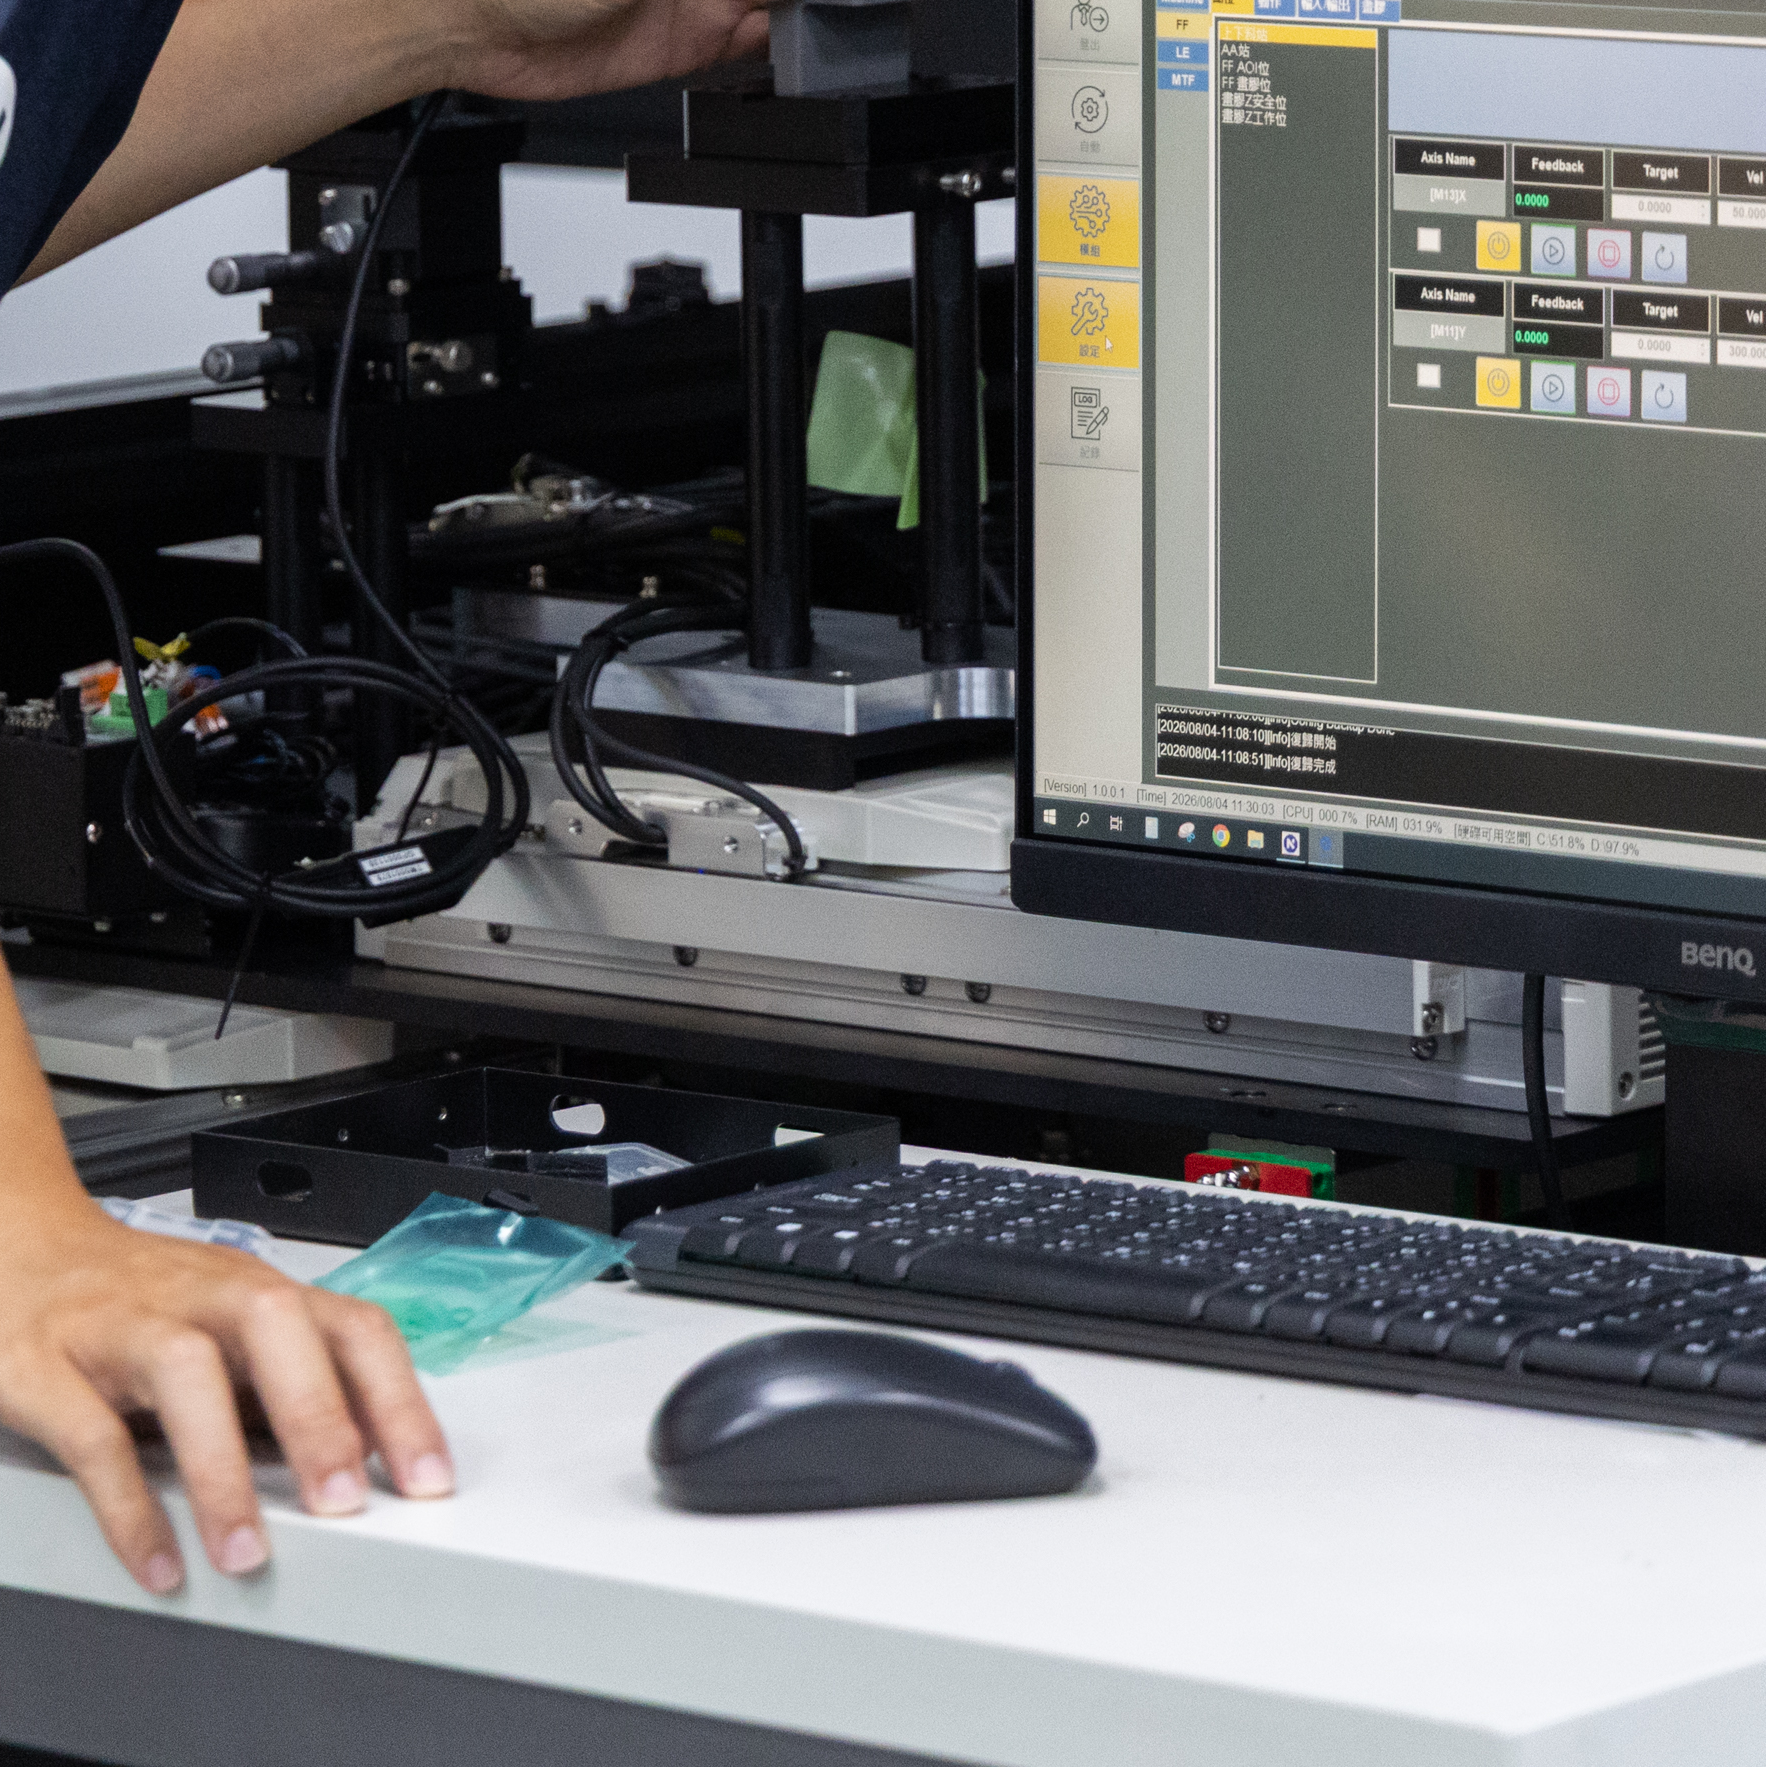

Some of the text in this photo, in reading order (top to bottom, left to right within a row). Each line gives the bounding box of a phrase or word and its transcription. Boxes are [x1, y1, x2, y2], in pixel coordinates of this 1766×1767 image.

[1176, 19, 1189, 31] FF
[1176, 46, 1190, 59] LE
[1220, 43, 1250, 59] AA站
[1221, 59, 1271, 77] FF AOI位
[1171, 73, 1196, 87] MTF
[1221, 75, 1234, 90] FF
[1421, 150, 1476, 167] Axis Name
[1531, 157, 1584, 174] Feedback
[1643, 163, 1679, 182] Target
[1746, 169, 1764, 184] Vel
[1429, 187, 1467, 204] [M13]X
[1515, 192, 1550, 208] 0.0000
[1638, 199, 1672, 215] 0.0000
[1732, 205, 1766, 220] 50.000
[1421, 286, 1476, 303] Axis Name
[1531, 294, 1584, 311] Feedback
[1642, 301, 1679, 320] Target
[1745, 309, 1764, 324] Vel
[1514, 329, 1549, 345] 0.0000
[1637, 337, 1672, 352] 0.0000
[1078, 395, 1093, 405] LOG
[1043, 778, 1087, 797] [Version]
[1093, 784, 1125, 799] 1.0.0.1
[1137, 788, 1167, 805] [Time]
[1171, 795, 1228, 810] 2026/08/04
[1232, 800, 1275, 816] 11:30:03
[1283, 804, 1313, 822] [CPU]
[1318, 808, 1358, 825] 000.7%
[1366, 813, 1398, 831] [RAM]
[1403, 818, 1443, 834] 031.9%
[1681, 941, 1756, 978] BenQ
